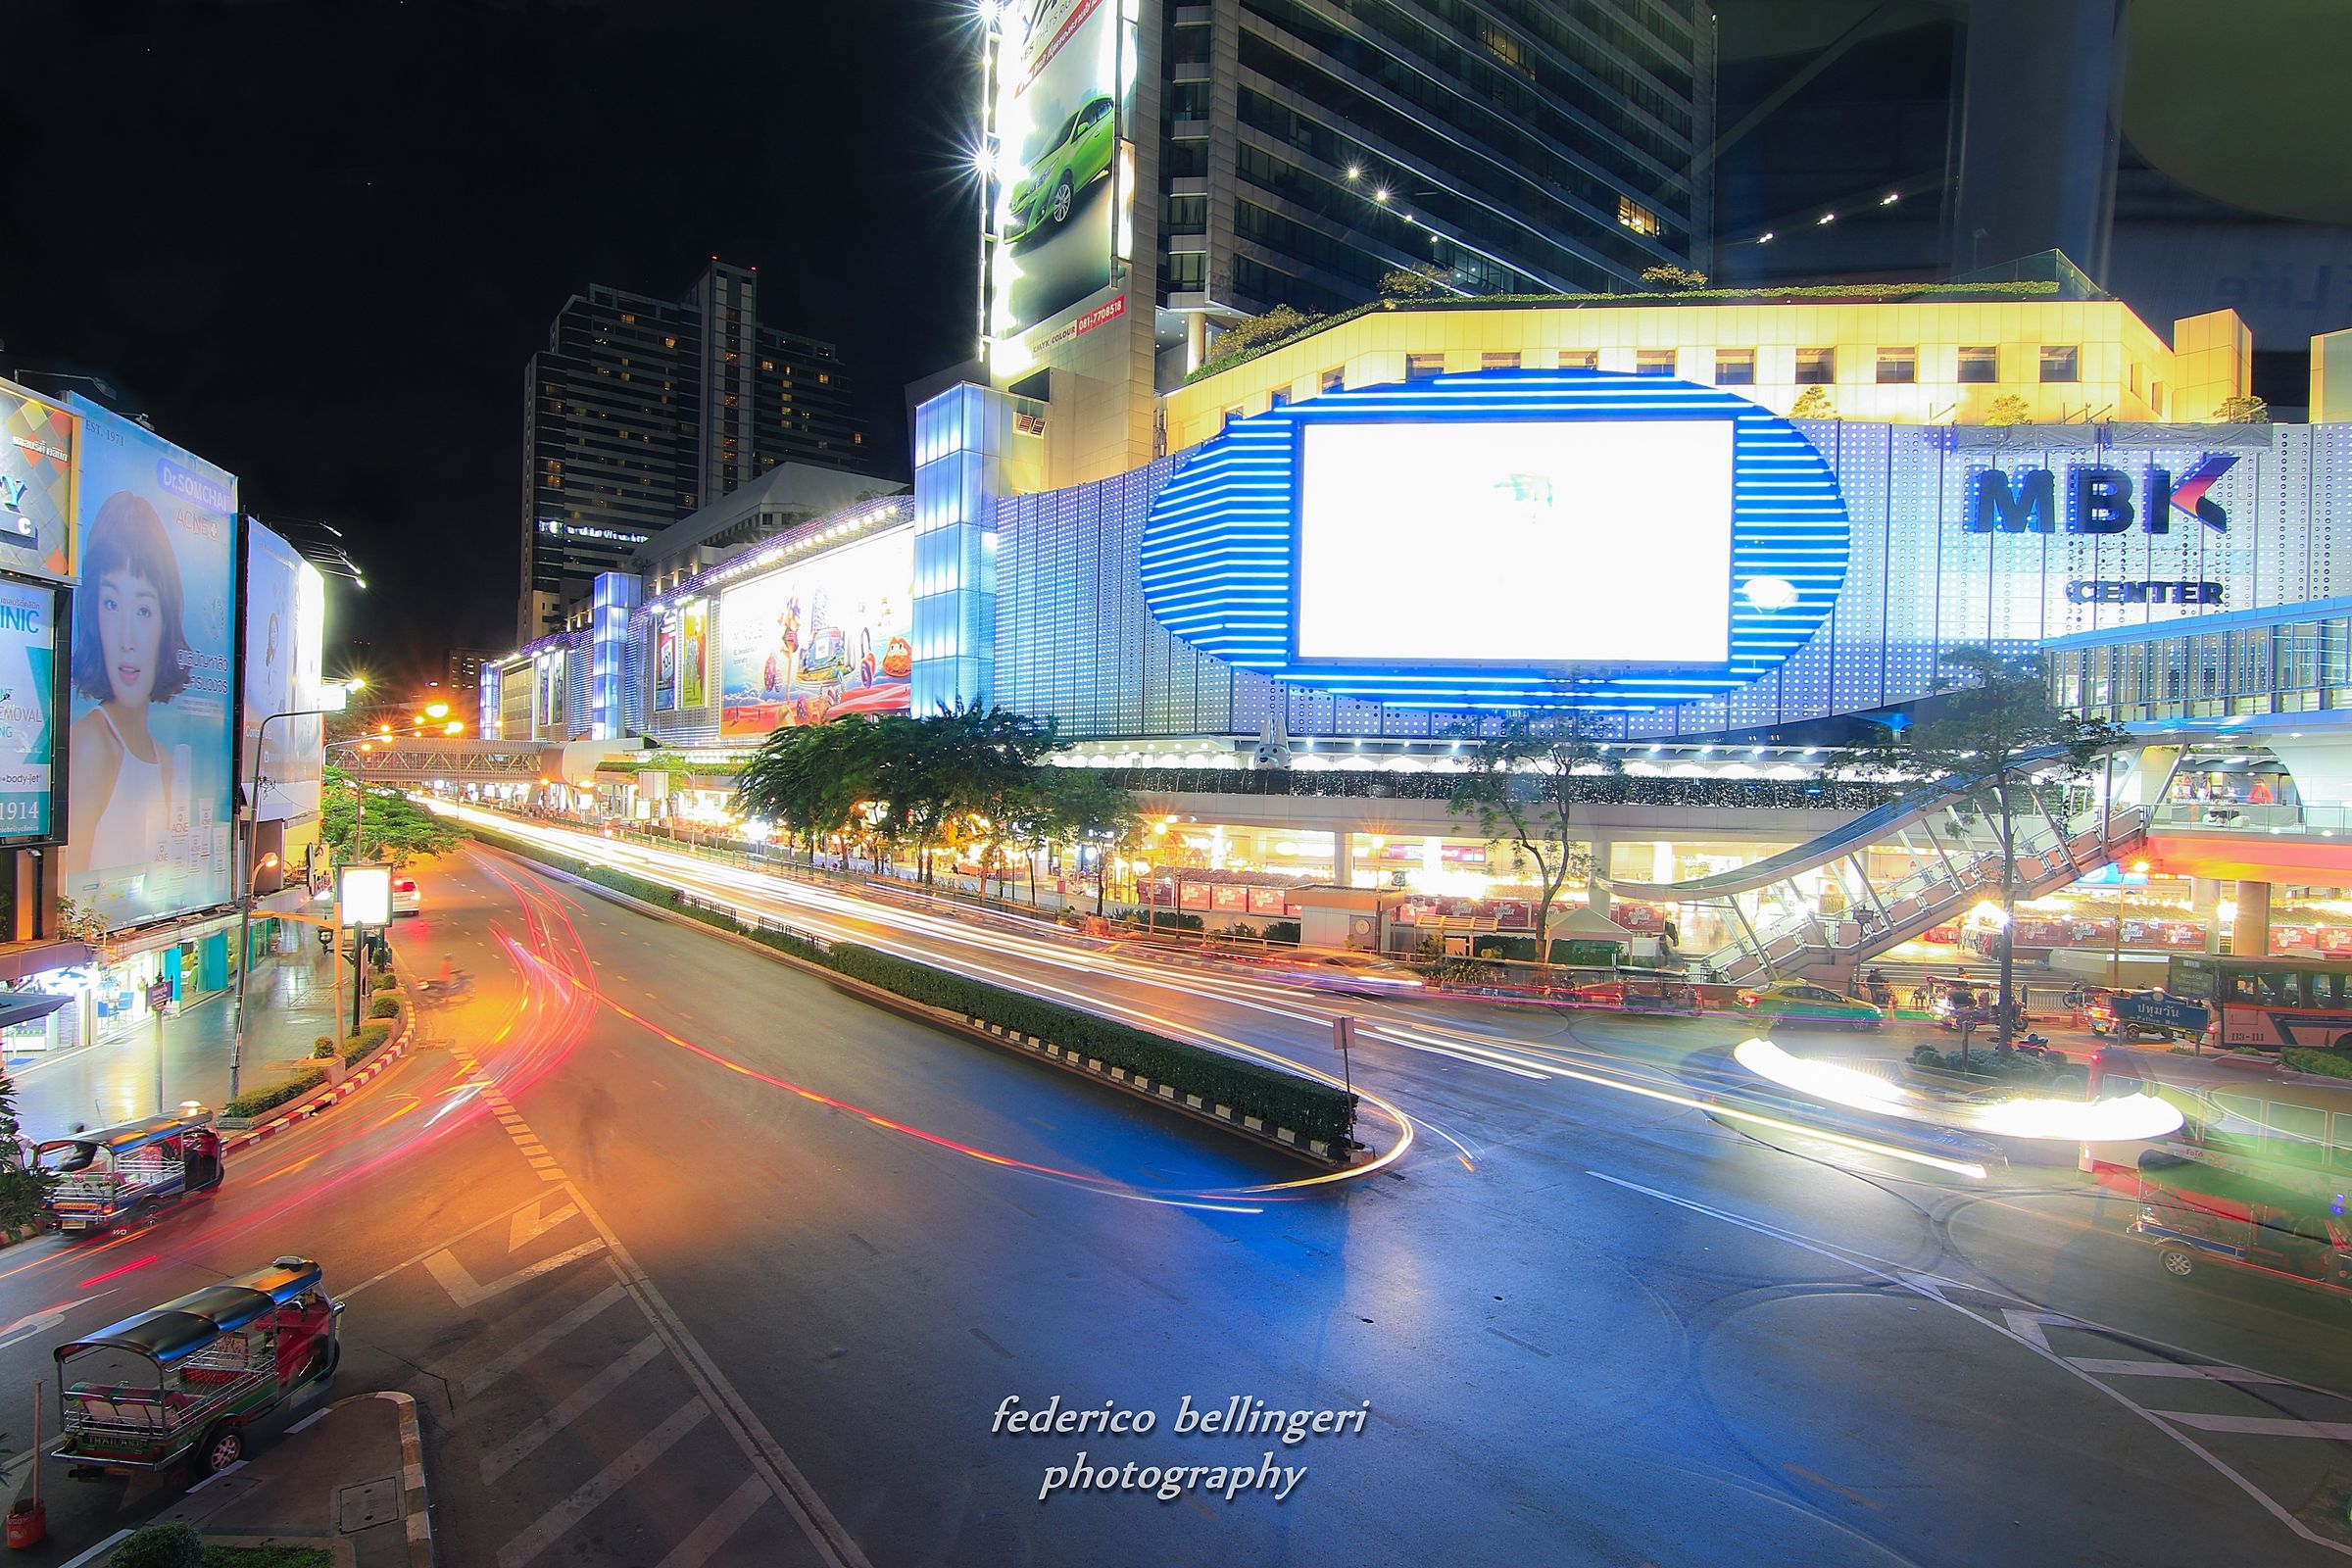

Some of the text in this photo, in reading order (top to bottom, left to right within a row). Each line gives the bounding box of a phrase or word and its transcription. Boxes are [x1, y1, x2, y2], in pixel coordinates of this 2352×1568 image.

[1052, 325, 1076, 344] COLOUR
[1078, 299, 1122, 331] 081-7708518
[86, 419, 124, 447] EST. 1971
[164, 466, 227, 512] Dr.SOMCHAI
[1961, 454, 2242, 535] MBK
[175, 509, 209, 537] ACNE
[2064, 580, 2225, 605] CENTER
[2137, 1004, 2180, 1018] ปทุมวัน
[88, 1436, 148, 1447] THAILAND
